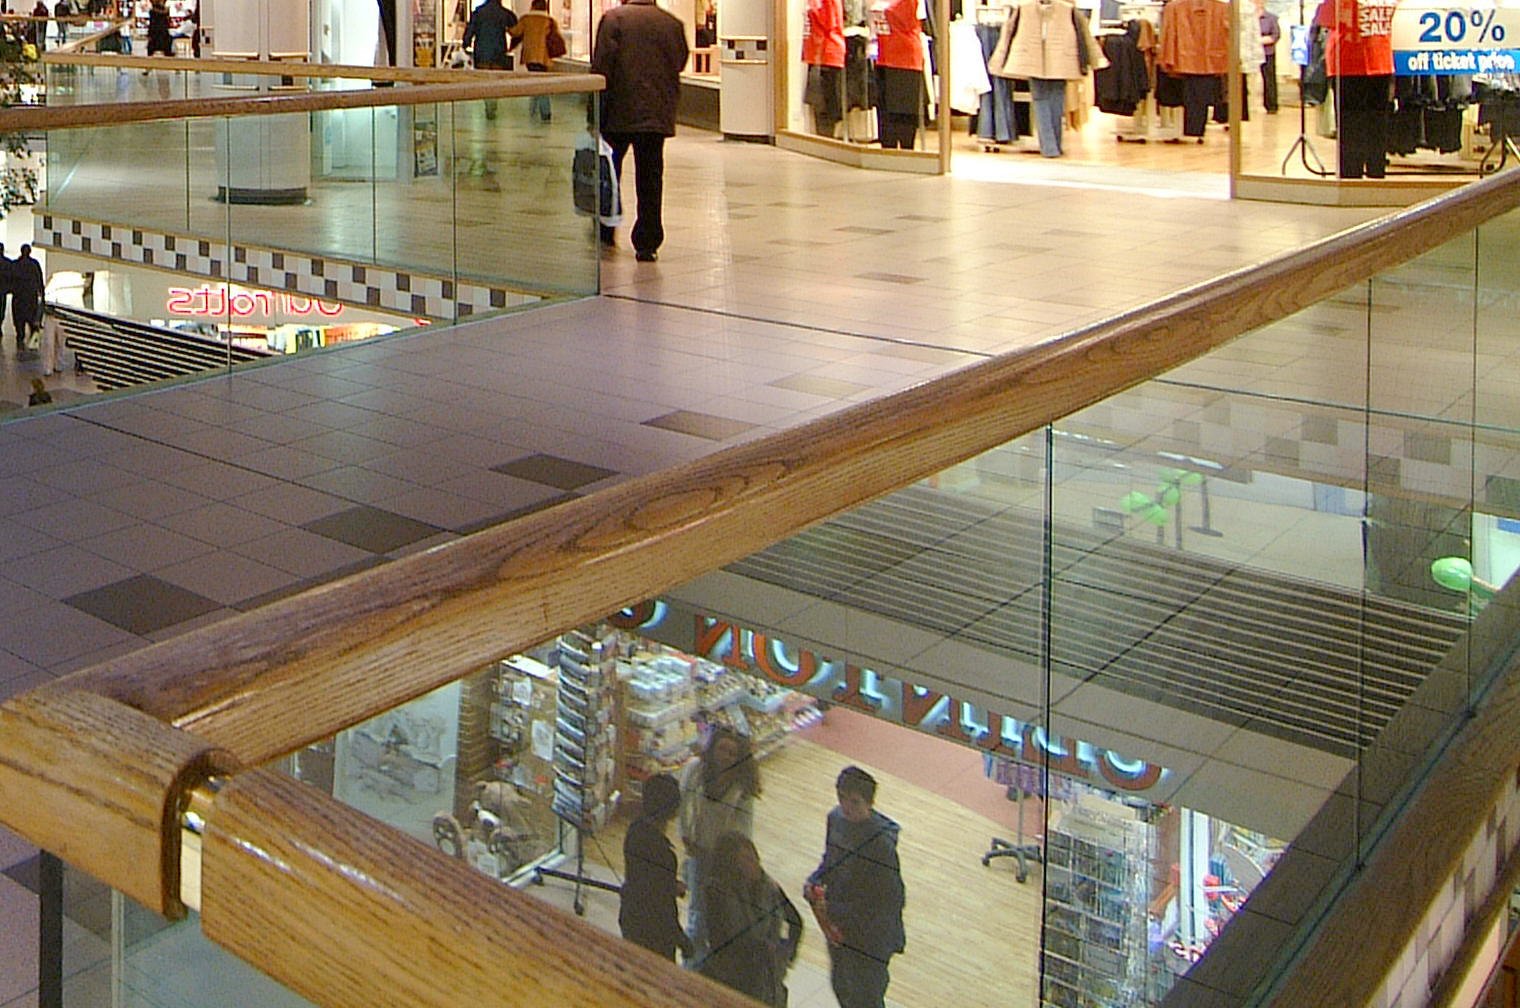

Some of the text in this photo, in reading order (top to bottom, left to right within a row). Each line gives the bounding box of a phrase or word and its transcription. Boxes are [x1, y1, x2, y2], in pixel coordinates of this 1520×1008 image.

[1418, 9, 1506, 43] 20%
[1407, 51, 1431, 72] off
[1432, 51, 1476, 71] ticket
